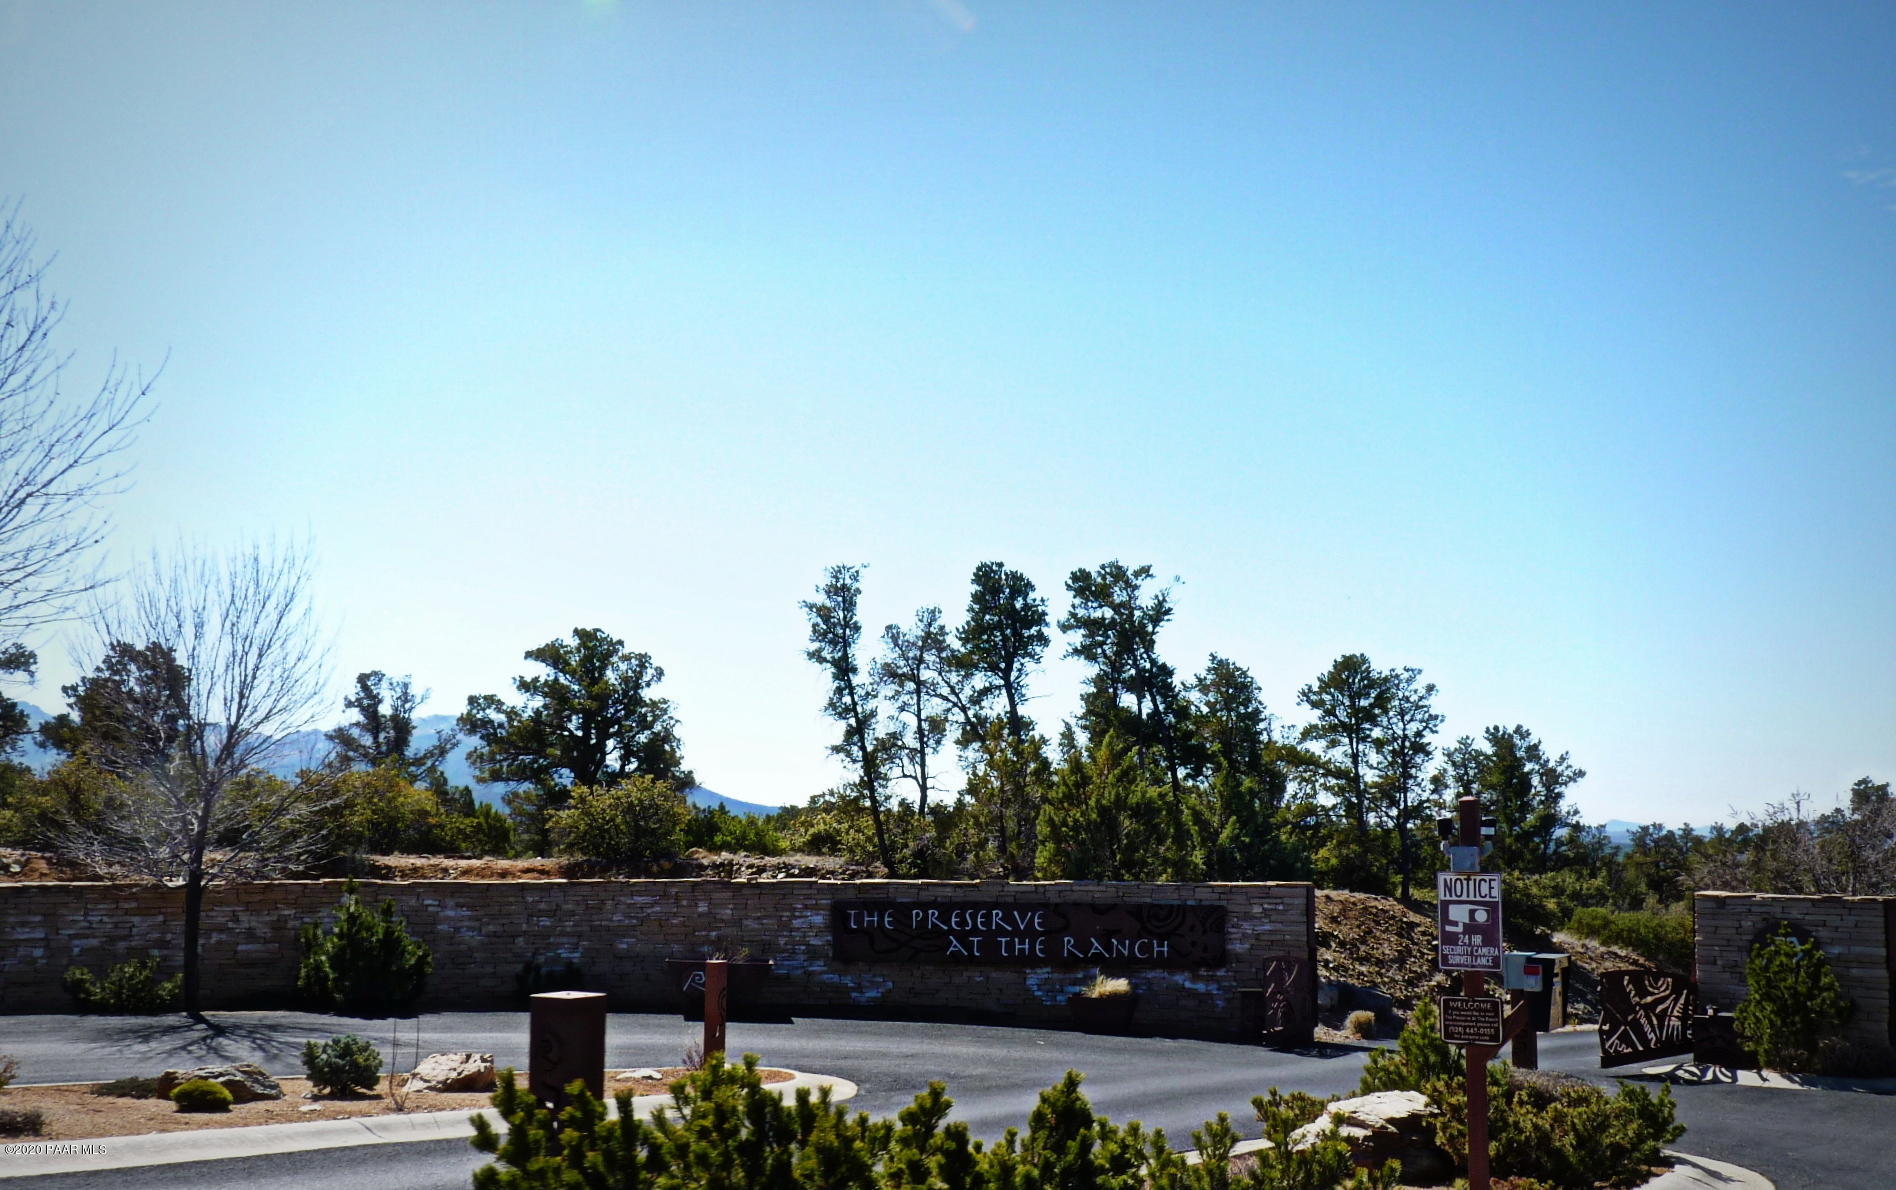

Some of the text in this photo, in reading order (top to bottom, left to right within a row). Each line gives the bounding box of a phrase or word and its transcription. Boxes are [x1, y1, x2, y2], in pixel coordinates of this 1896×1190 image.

[1443, 877, 1498, 899] NOTICE
[847, 909, 1045, 932] THE PRESERVE
[1458, 934, 1482, 946] 24 HR
[946, 935, 1169, 959] AT THE RANCH
[1442, 945, 1499, 957] SECURITY CAMERA
[1448, 955, 1494, 966] SURVEILLANCE
[1449, 1001, 1493, 1010] WELCOME
